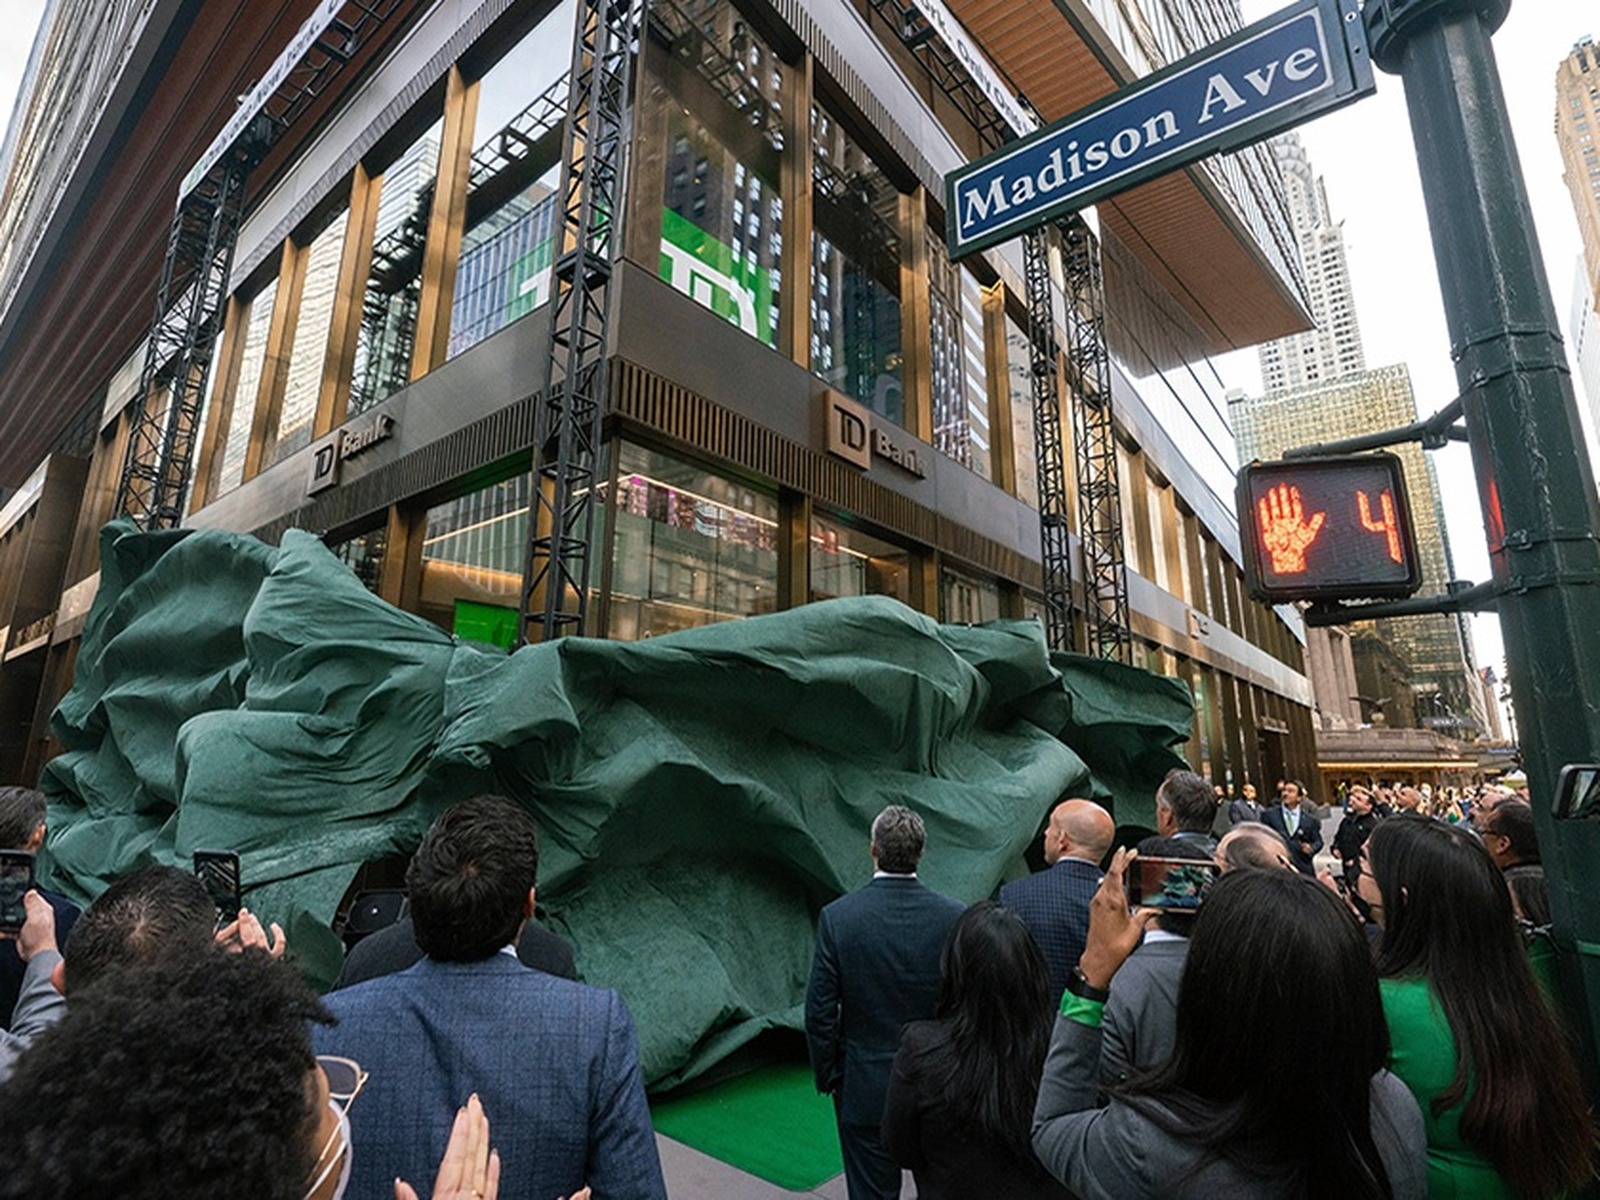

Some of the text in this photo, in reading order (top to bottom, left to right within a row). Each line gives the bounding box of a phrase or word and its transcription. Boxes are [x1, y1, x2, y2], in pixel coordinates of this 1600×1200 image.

[957, 39, 991, 94] Only
[963, 46, 1320, 229] Madison Ave
[314, 413, 393, 481] TD Bank
[834, 404, 926, 478] TD Bank
[1357, 488, 1402, 564] 4
